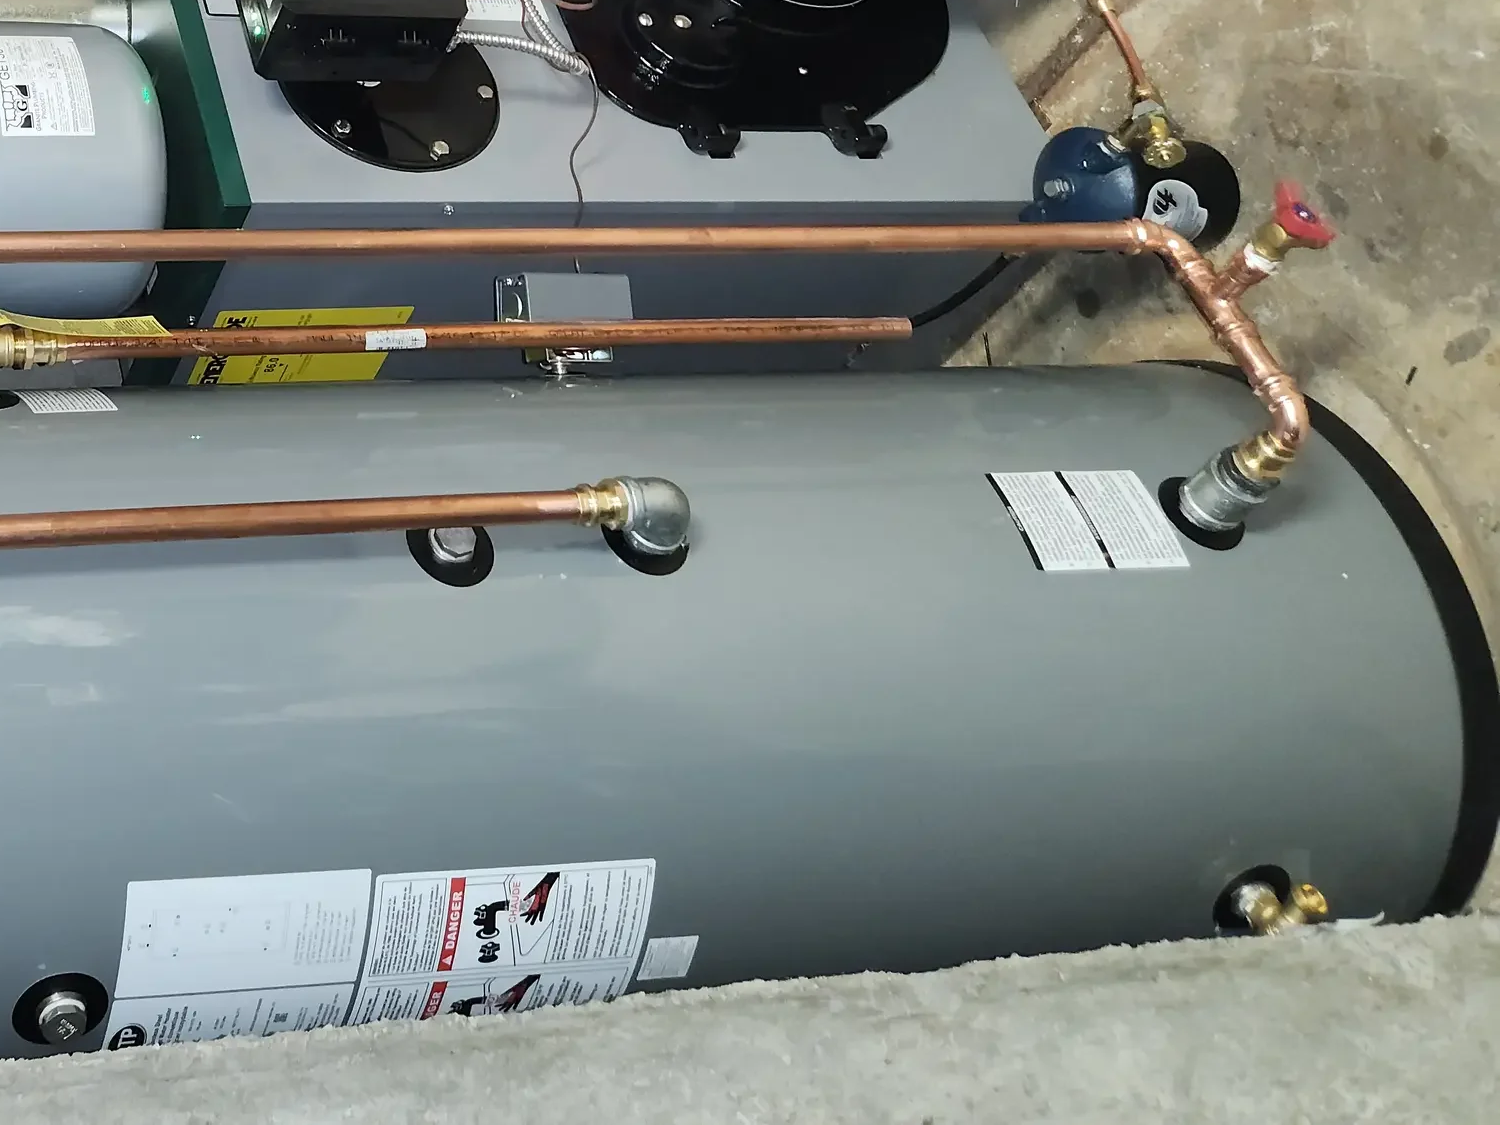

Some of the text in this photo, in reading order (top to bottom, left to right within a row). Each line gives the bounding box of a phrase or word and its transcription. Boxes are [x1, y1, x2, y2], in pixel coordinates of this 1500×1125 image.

[17, 101, 27, 111] G
[263, 357, 279, 372] 86.0
[508, 881, 521, 923] CHAUDE
[445, 891, 462, 950] DANGER
[117, 1028, 137, 1048] TP
